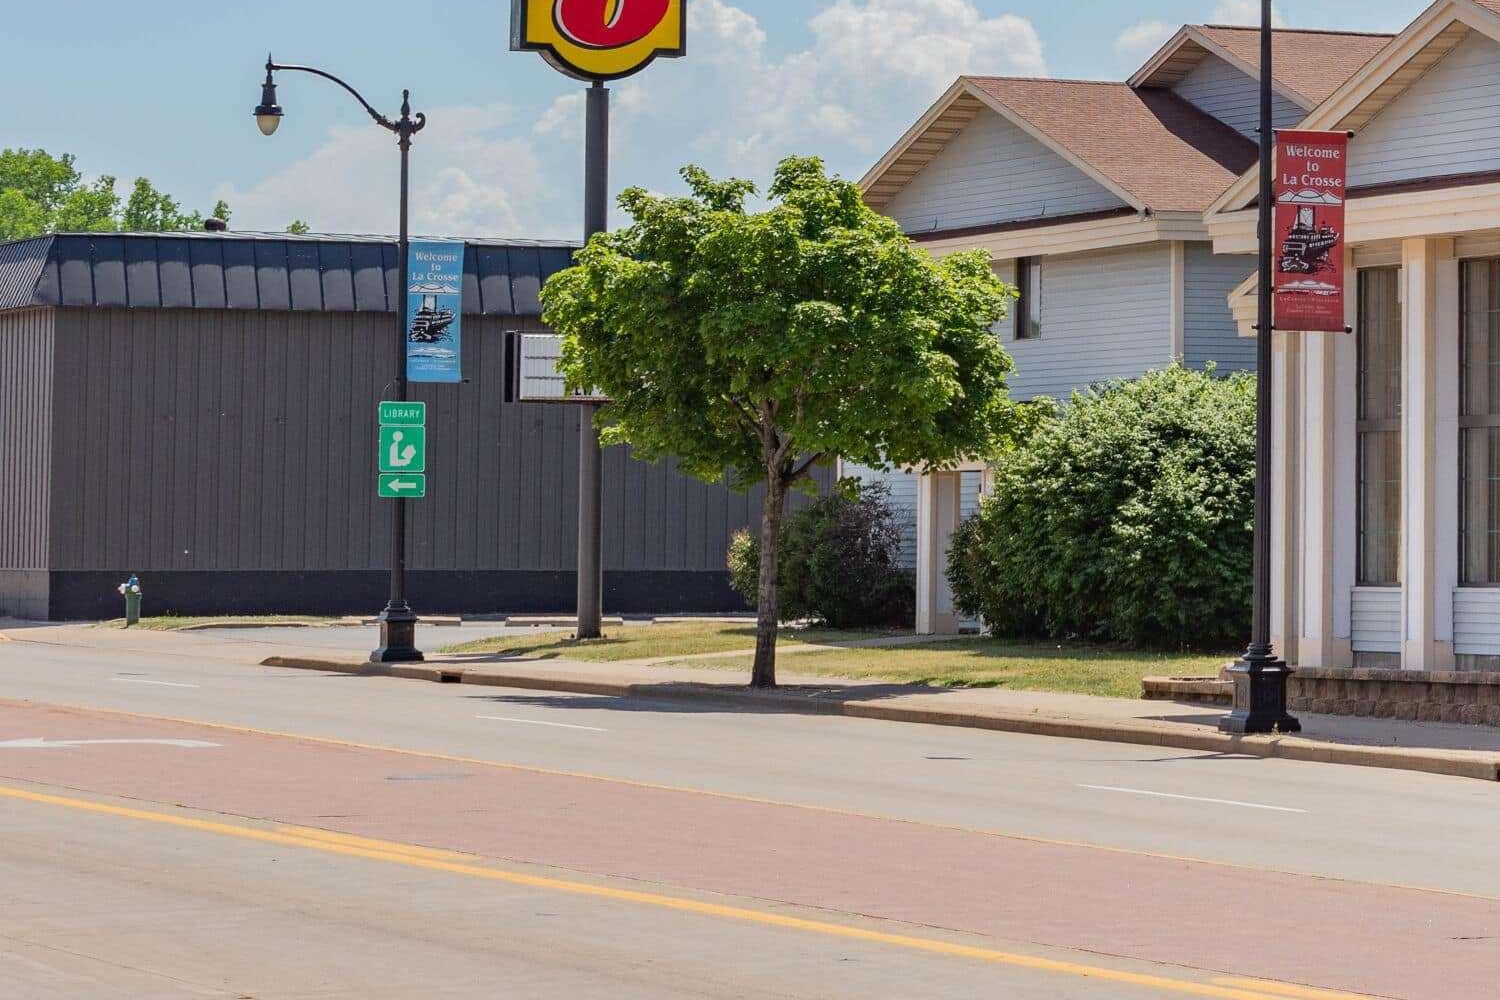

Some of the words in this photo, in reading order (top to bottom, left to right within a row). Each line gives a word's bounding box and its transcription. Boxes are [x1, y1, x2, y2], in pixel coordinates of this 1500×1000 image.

[1286, 145, 1340, 159] Welcome
[1306, 160, 1319, 172] to
[1282, 173, 1297, 185] La
[1301, 174, 1342, 187] Crosse
[415, 250, 458, 262] Welcome
[431, 263, 441, 271] to
[412, 272, 424, 281] La
[427, 272, 458, 281] Crosse
[383, 408, 420, 418] LIBRARY
